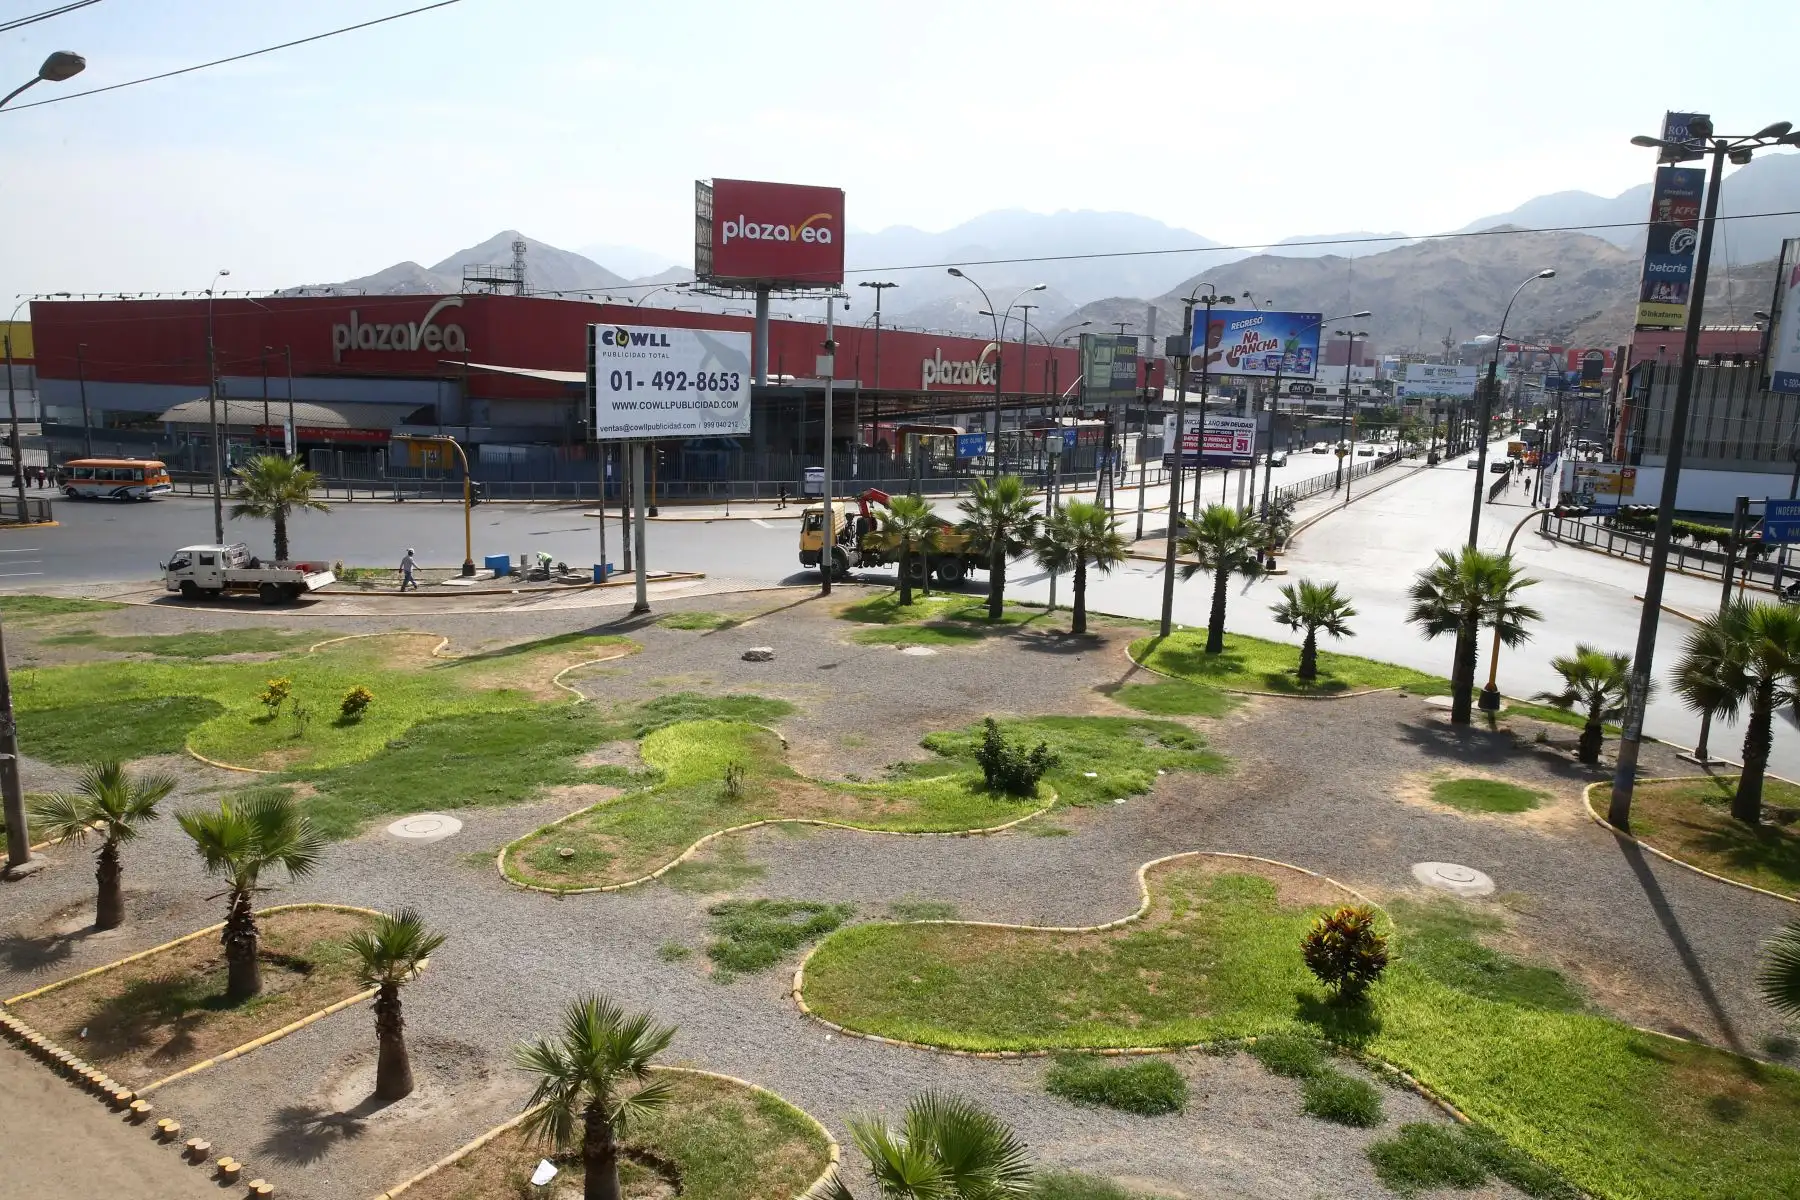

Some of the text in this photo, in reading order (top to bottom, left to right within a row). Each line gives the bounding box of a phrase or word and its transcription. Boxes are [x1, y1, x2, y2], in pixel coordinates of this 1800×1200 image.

[1674, 206, 1698, 216] KFC
[722, 213, 832, 245] plazavea
[1649, 262, 1688, 274] betcris
[1231, 315, 1263, 331] REGRESÓ
[602, 327, 671, 349] COWLL
[1242, 329, 1260, 345] ÑA
[602, 351, 646, 359] PUBLICIDAD
[1231, 339, 1279, 359] PANCHA
[651, 371, 740, 392] 492-8653
[612, 400, 739, 411] WWW.COWLLPUBLICIDAD.COM
